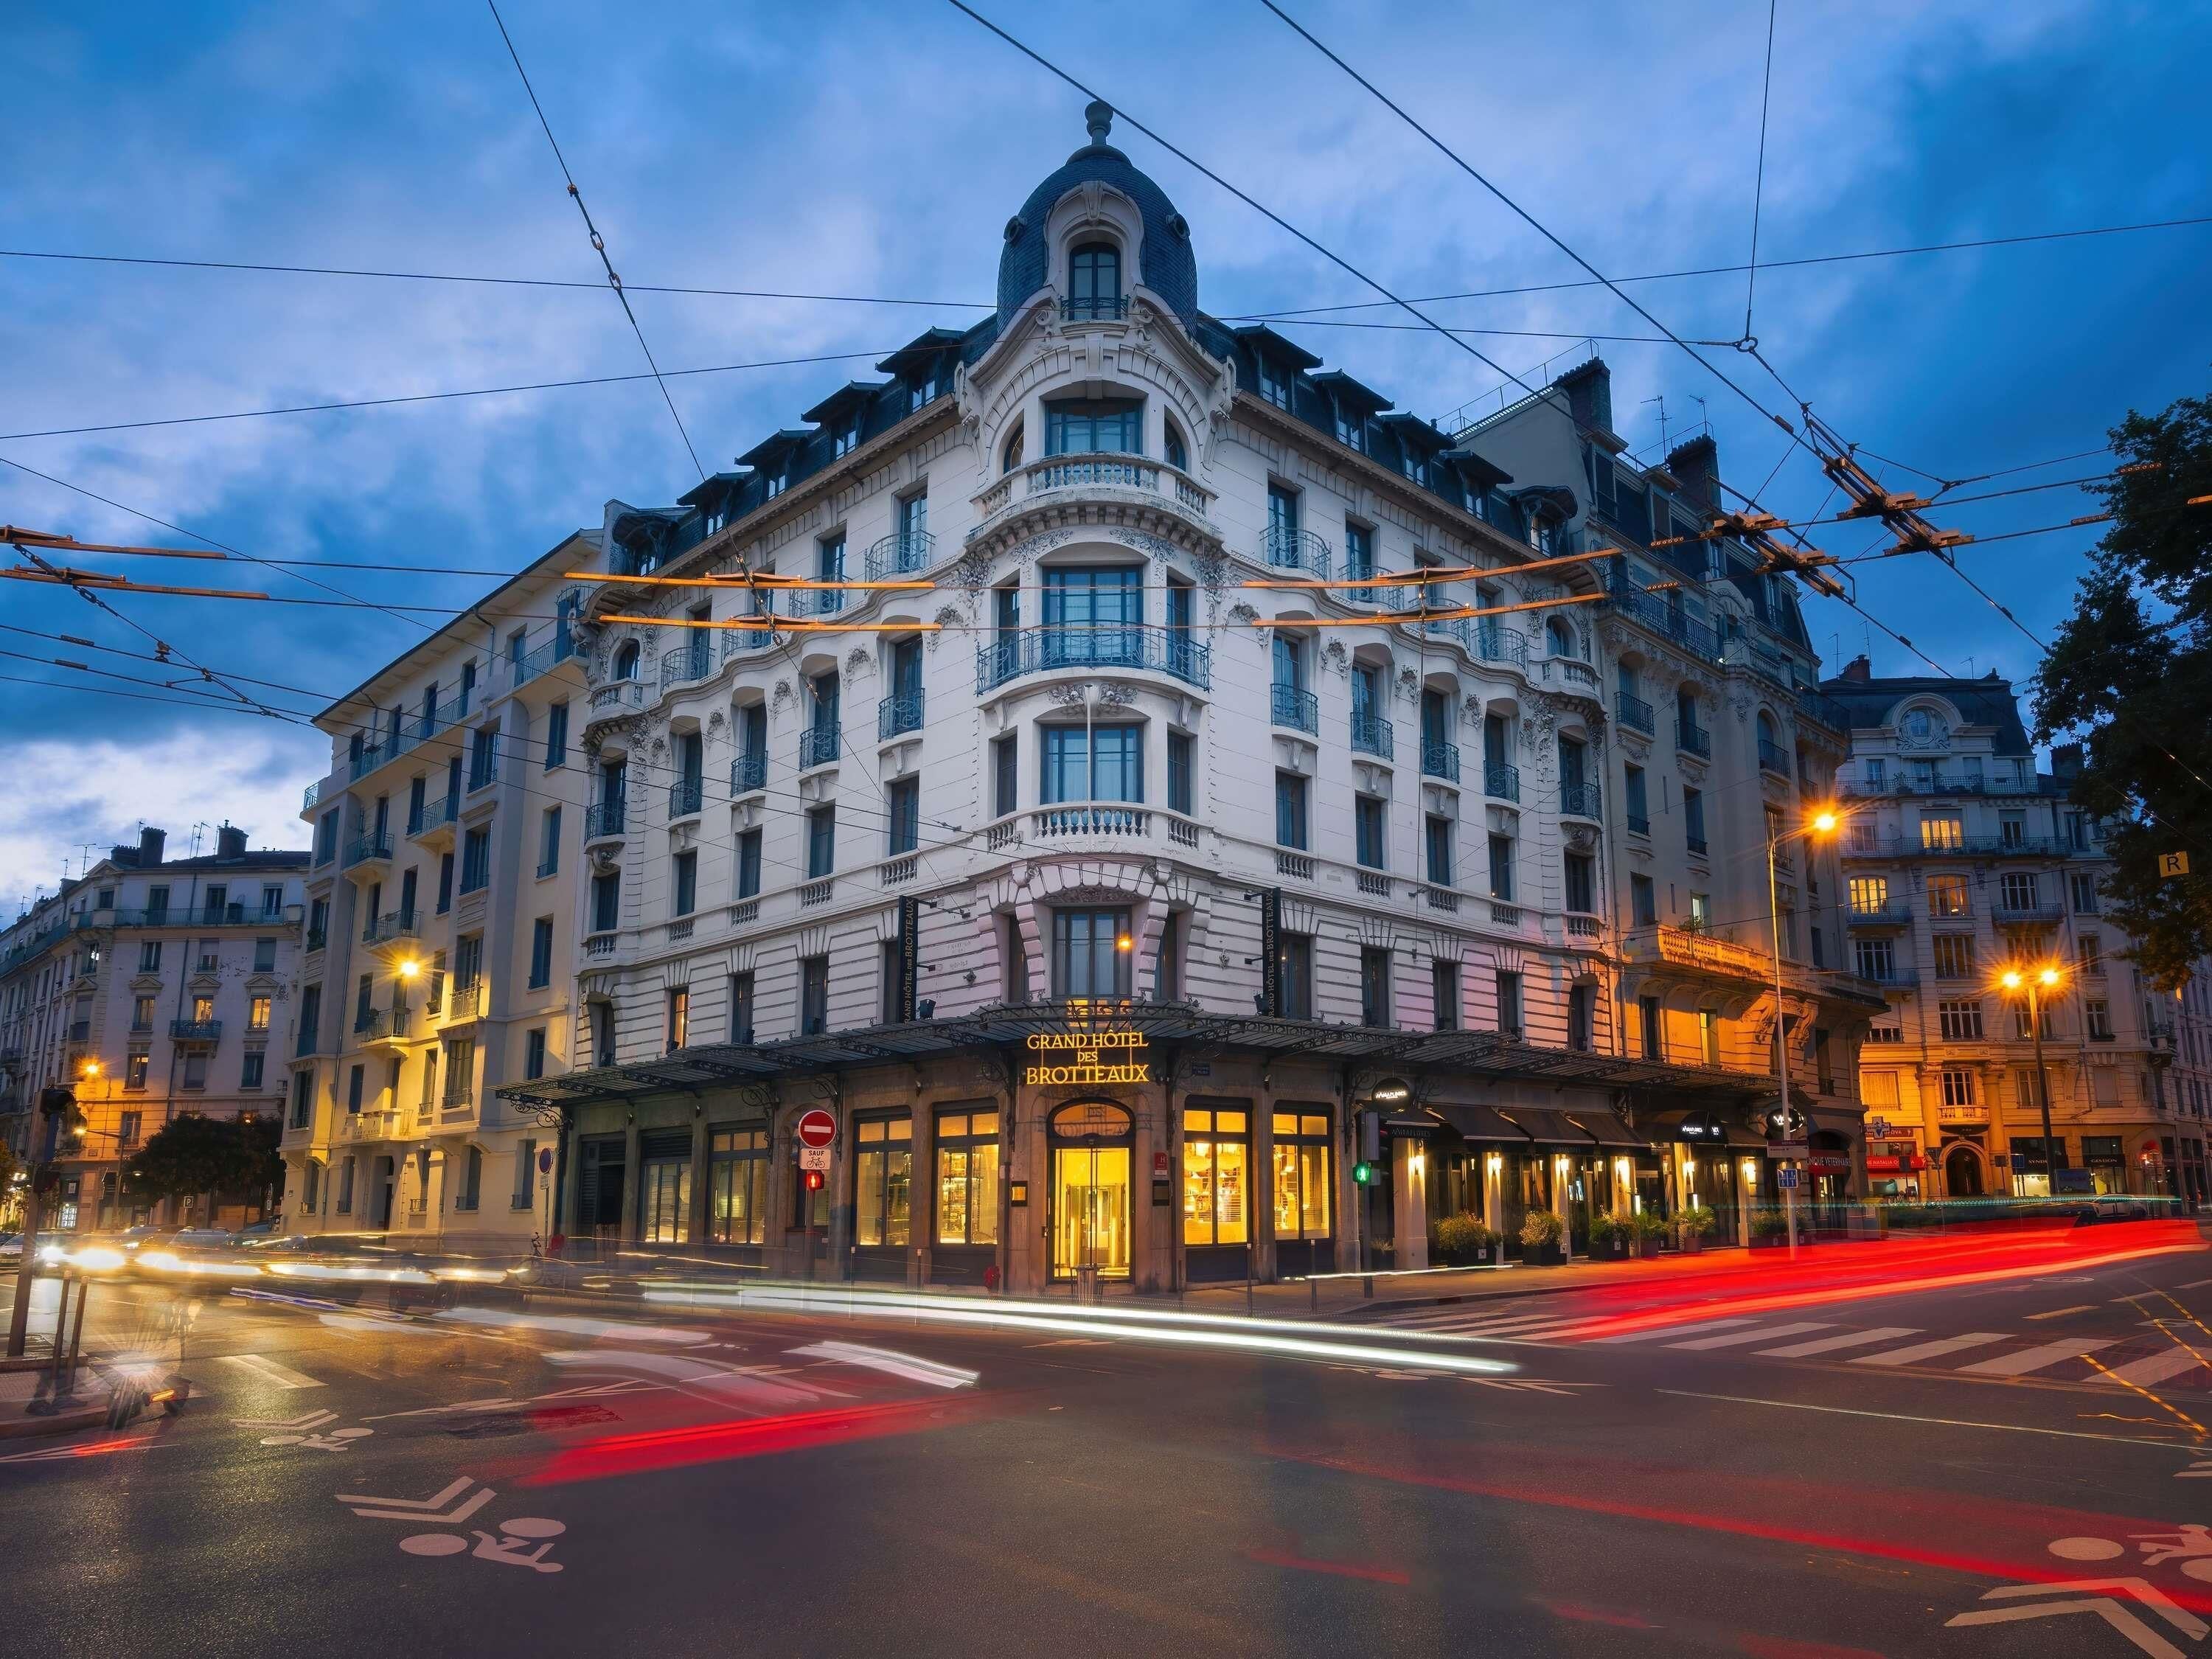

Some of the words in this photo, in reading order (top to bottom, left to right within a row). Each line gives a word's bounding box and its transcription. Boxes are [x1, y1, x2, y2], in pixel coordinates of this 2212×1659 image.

[2167, 856, 2181, 872] R
[905, 898, 914, 956] BROTTEAUX
[1265, 891, 1275, 950] BROTTEAUX
[1027, 1034, 1088, 1049] GRAND
[1093, 1029, 1149, 1048] HÔTEL
[1077, 1051, 1098, 1062] DES
[1026, 1064, 1150, 1085] BROTTEAUX
